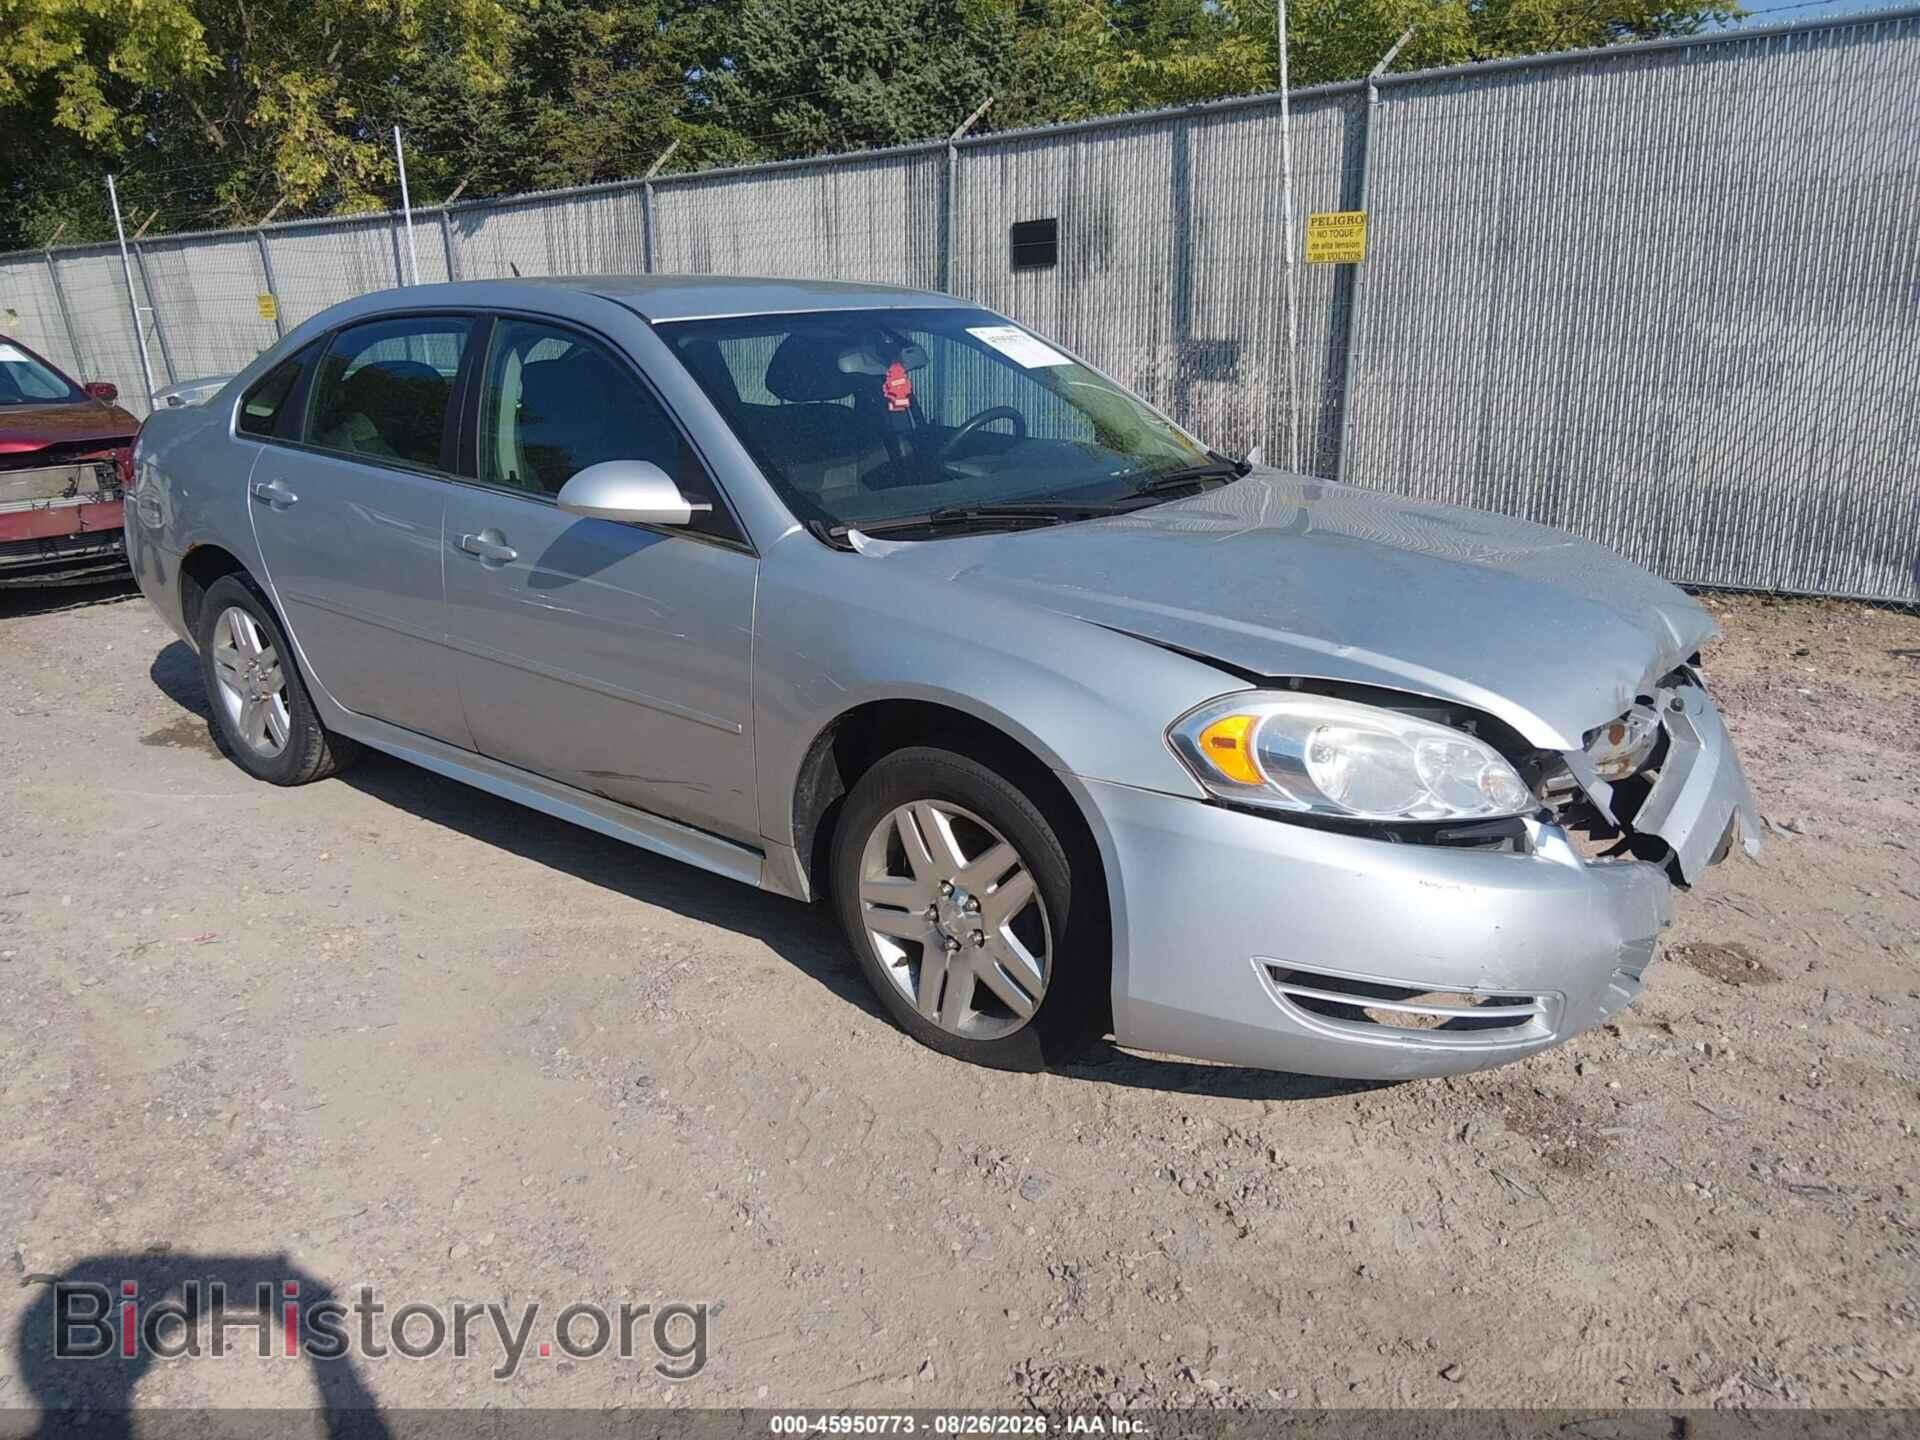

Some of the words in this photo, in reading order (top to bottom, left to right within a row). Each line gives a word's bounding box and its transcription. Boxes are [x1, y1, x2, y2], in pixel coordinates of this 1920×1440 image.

[1311, 215, 1364, 226] PELIGRO
[1317, 230, 1328, 239] NO
[1329, 228, 1354, 238] TOQUE
[1327, 250, 1361, 261] VOLTIOS
